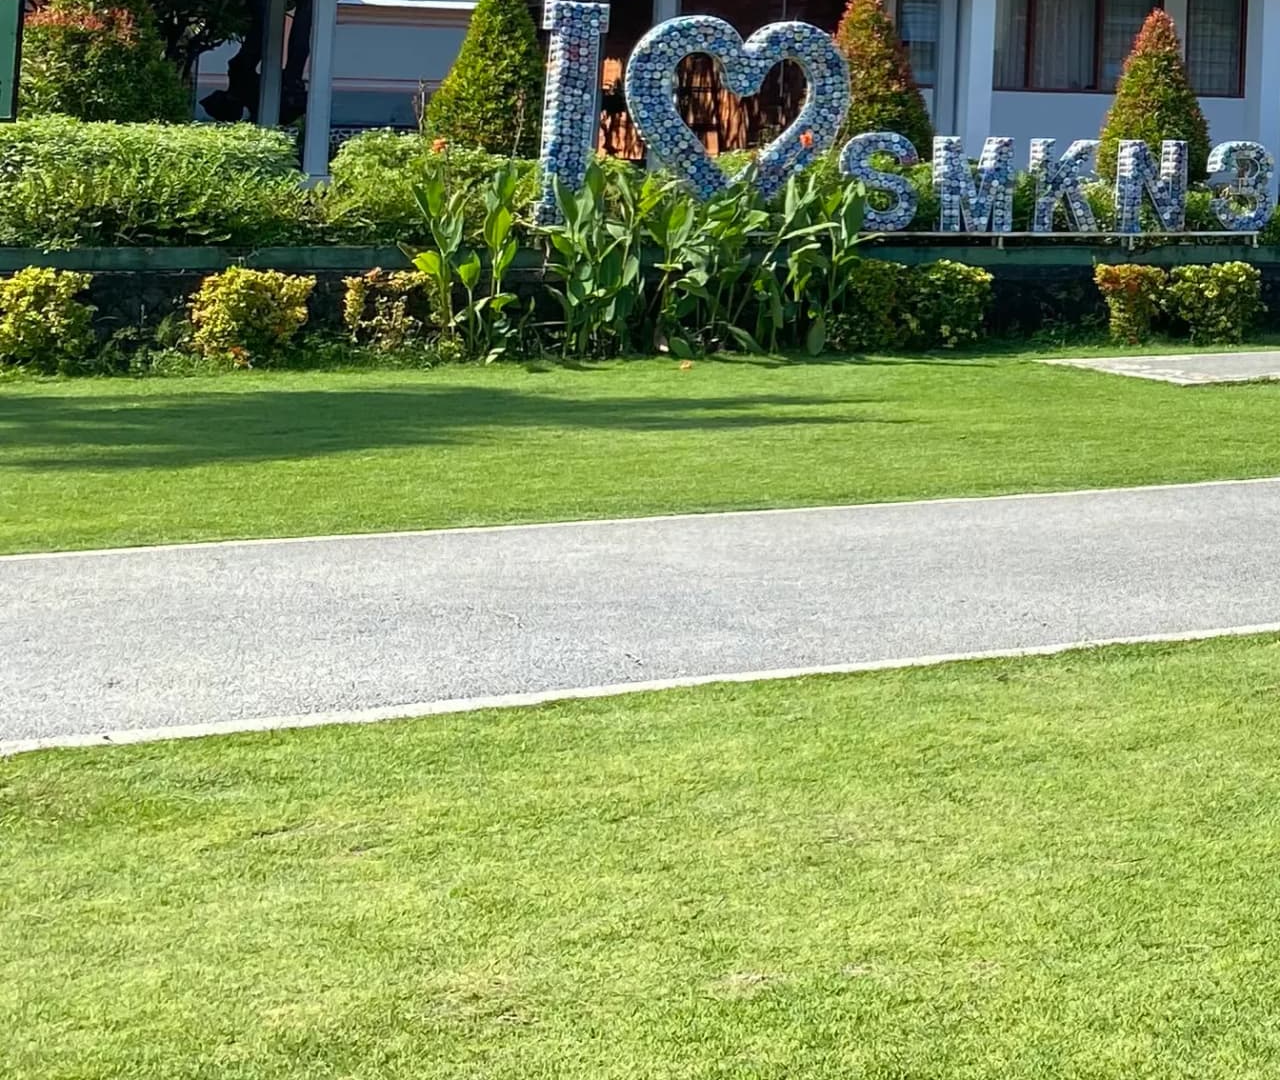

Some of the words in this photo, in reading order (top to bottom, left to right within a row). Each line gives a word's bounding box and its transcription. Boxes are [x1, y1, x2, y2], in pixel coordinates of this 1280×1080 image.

[533, 0, 610, 226] I
[839, 131, 1189, 233] SMKN
[1207, 140, 1275, 232] 3
